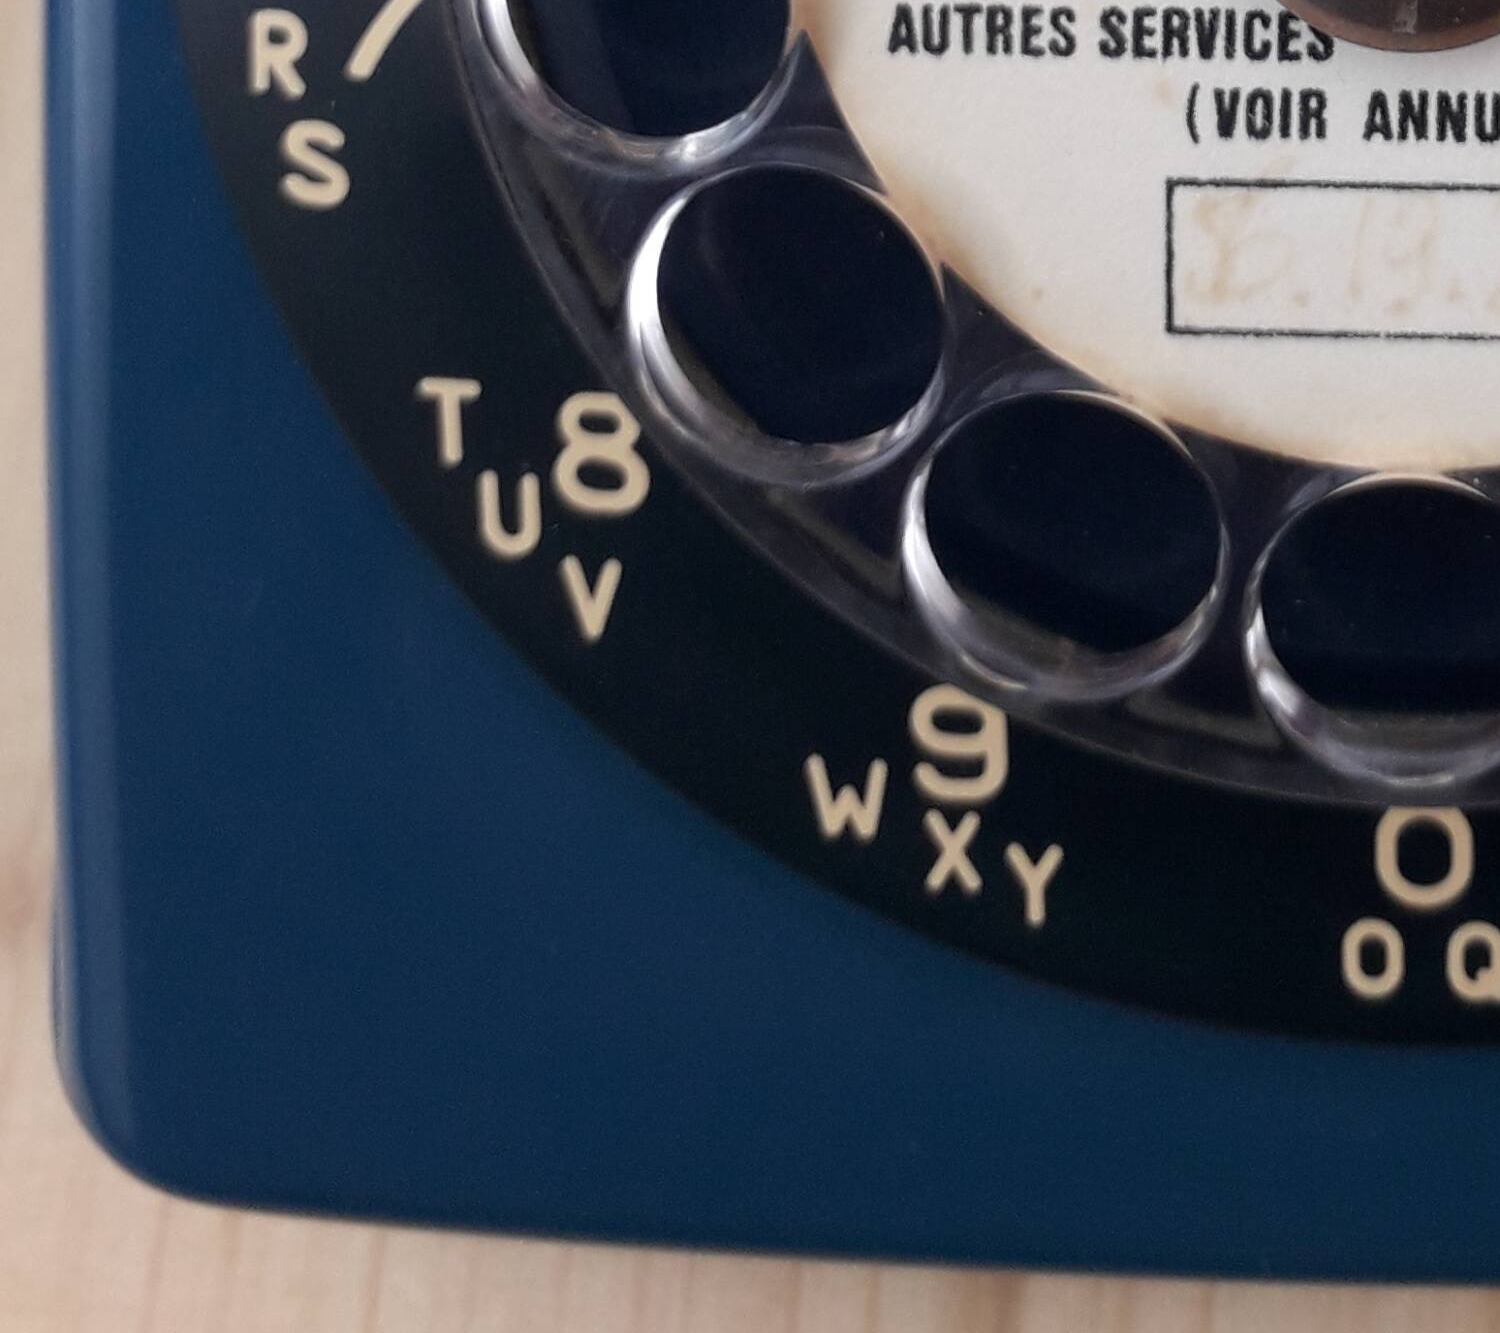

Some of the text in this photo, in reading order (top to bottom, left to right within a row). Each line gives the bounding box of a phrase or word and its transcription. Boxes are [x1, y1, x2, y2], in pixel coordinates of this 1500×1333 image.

[886, 3, 1078, 59] AUTRES
[1185, 82, 1328, 145] (VOIR
[553, 391, 650, 514] 8
[909, 683, 1008, 802] 9
